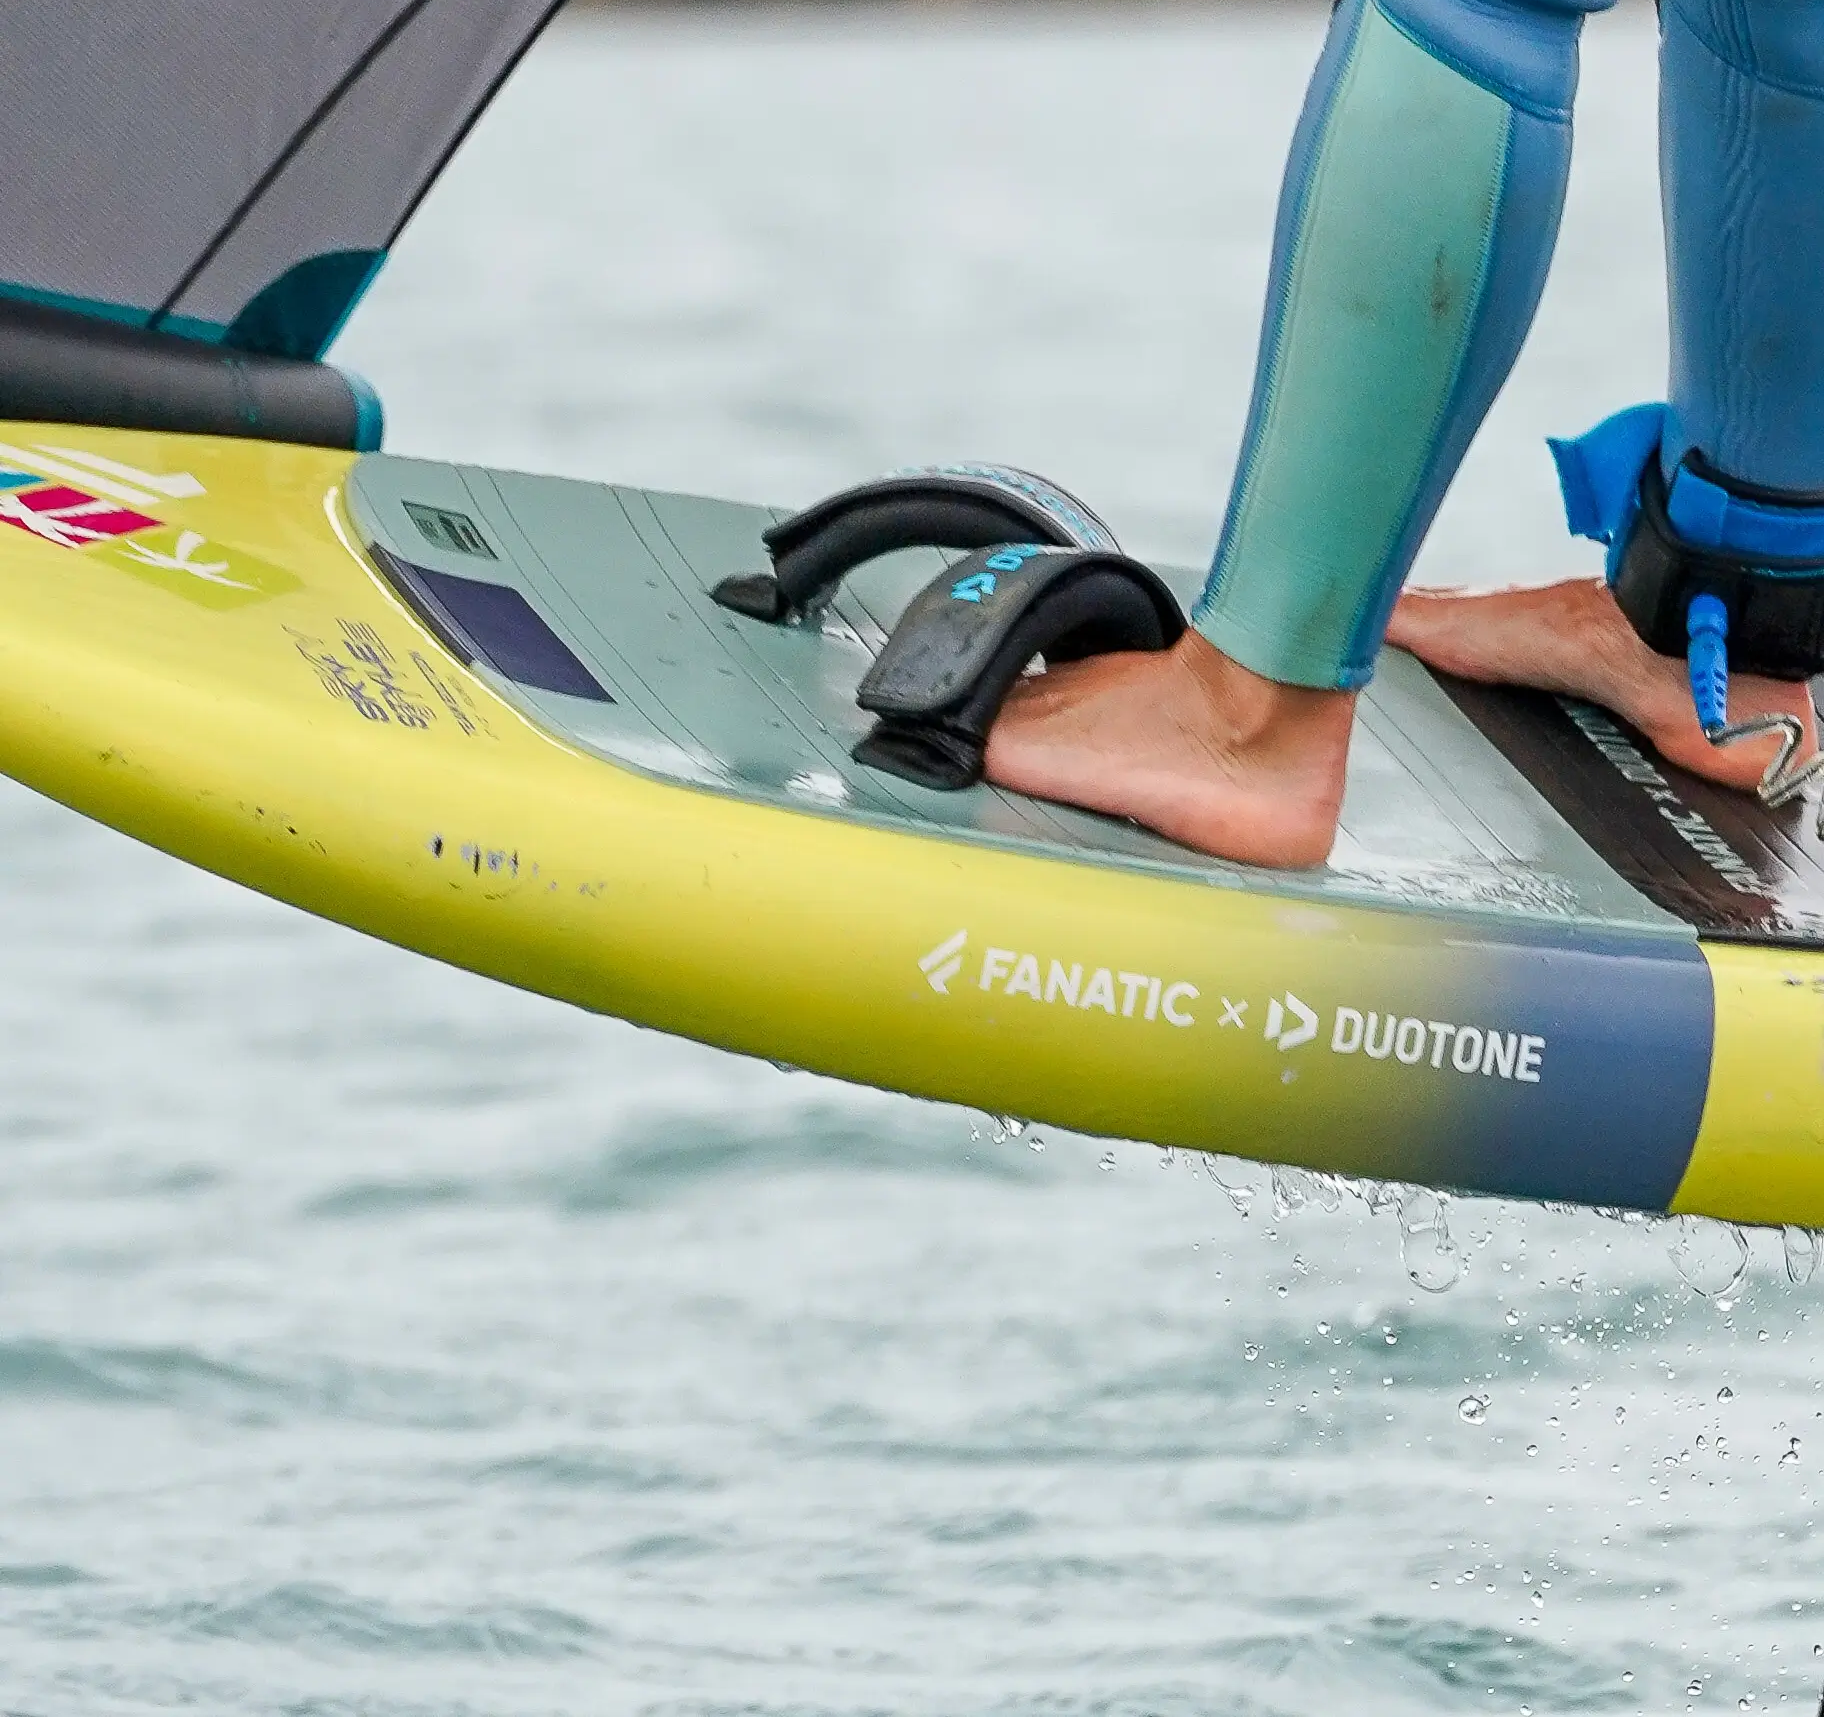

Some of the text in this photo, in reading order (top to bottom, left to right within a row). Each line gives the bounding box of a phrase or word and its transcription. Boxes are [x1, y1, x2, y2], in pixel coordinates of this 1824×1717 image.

[1658, 807, 1773, 898] FANATIC
[977, 946, 1199, 1027] FANATIC
[1331, 1007, 1546, 1084] DUOTONE
